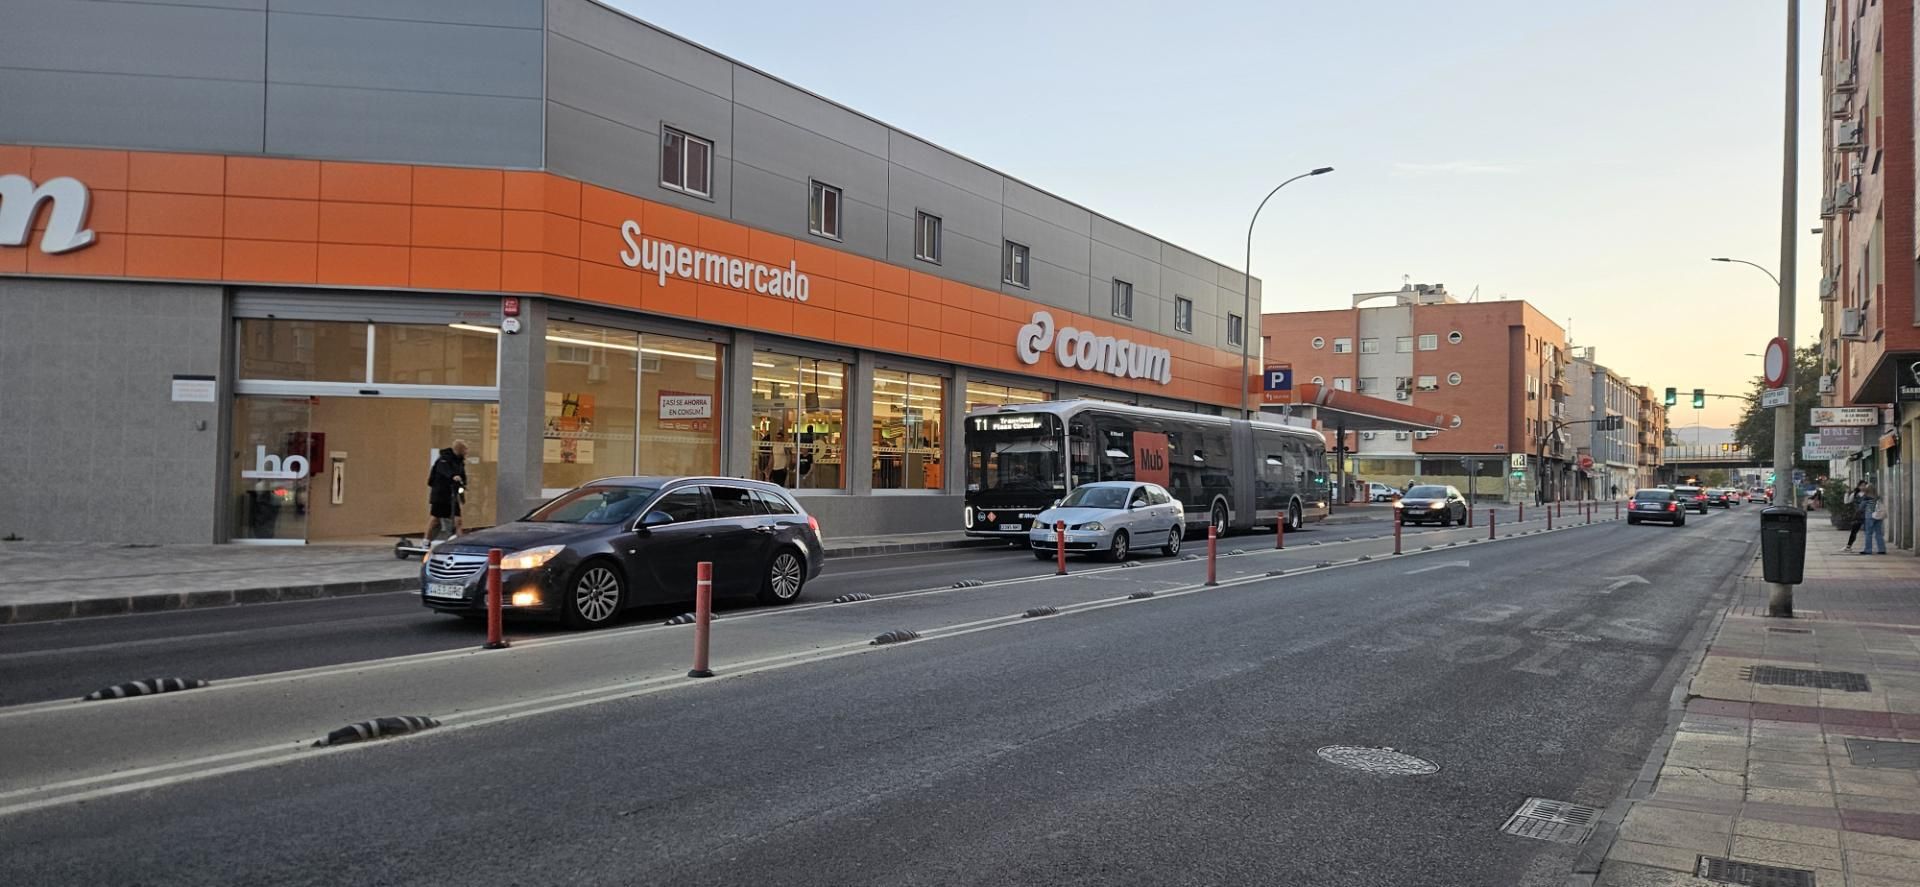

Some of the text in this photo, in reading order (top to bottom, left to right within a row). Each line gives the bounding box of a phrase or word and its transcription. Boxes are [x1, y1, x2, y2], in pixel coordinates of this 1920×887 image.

[619, 219, 809, 303] Supermercado
[1054, 326, 1172, 386] consum
[1271, 372, 1285, 389] P
[974, 418, 988, 431] T1
[992, 423, 1012, 431] Plaza
[1140, 447, 1164, 471] Mub
